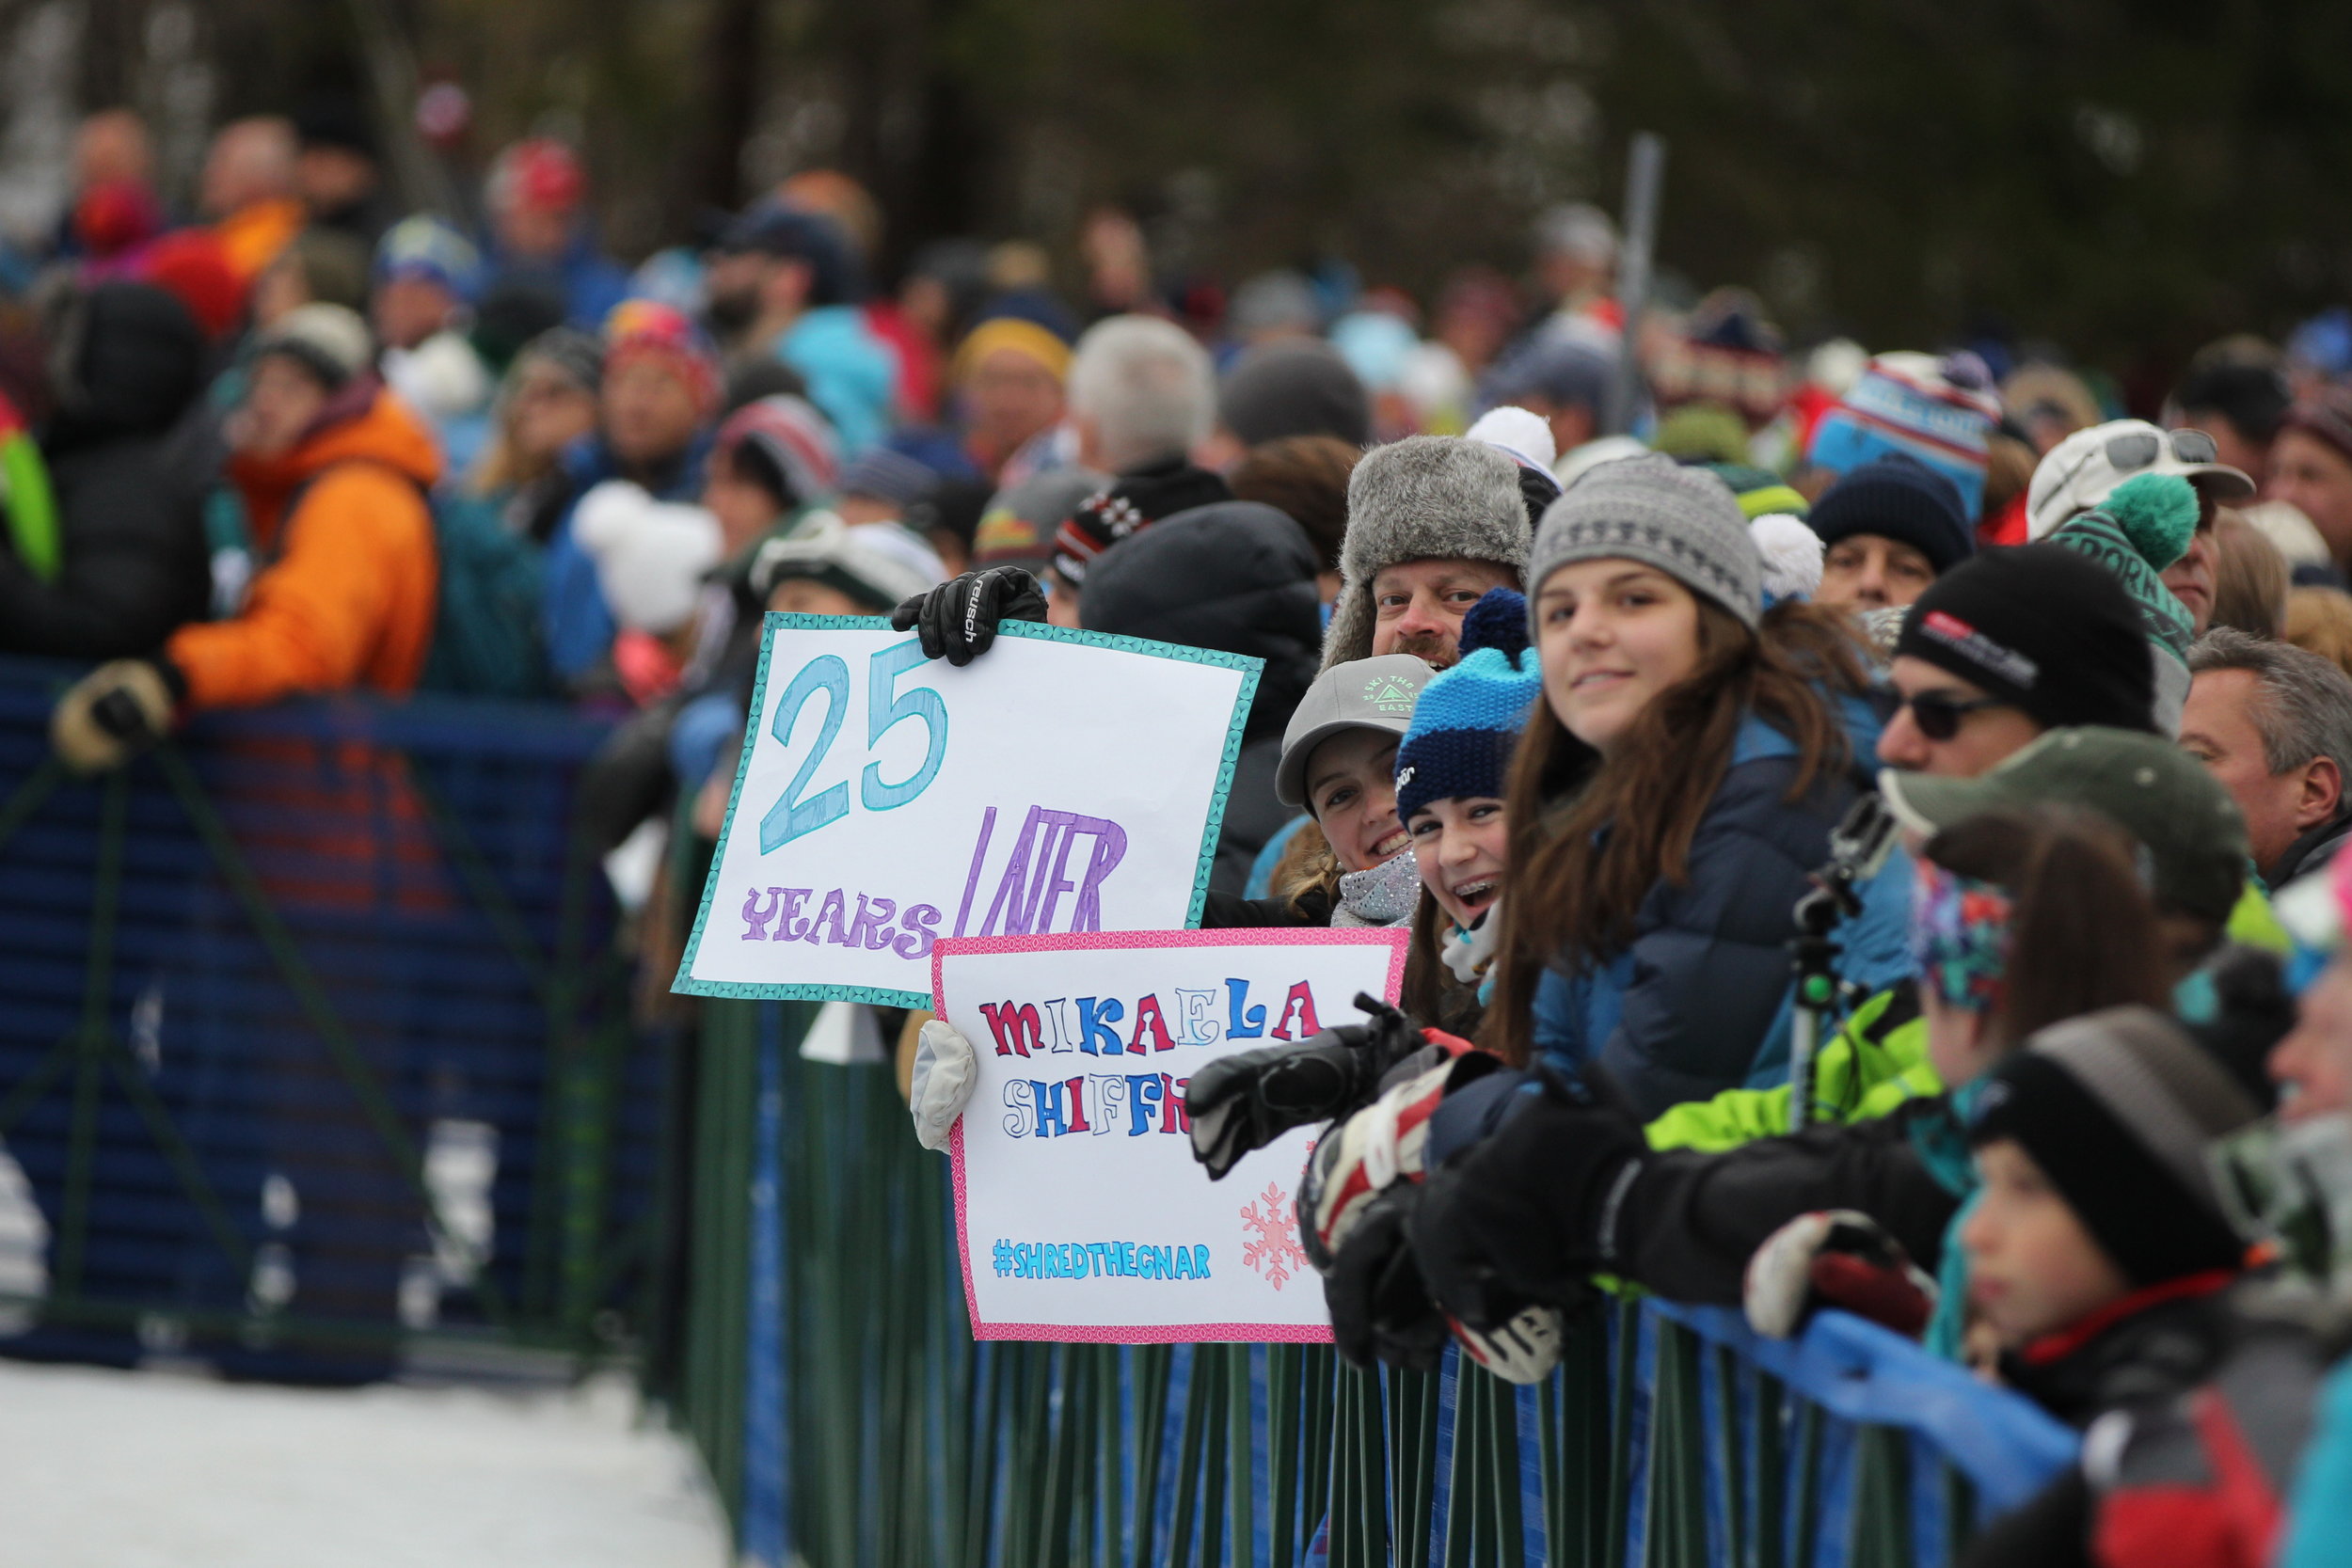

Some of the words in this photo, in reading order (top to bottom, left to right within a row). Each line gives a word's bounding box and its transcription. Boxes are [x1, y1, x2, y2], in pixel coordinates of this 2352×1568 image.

[964, 579, 984, 643] reusch
[1363, 676, 1384, 691] SKI
[1378, 704, 1413, 712] EAST
[759, 638, 949, 856] 25
[740, 886, 943, 960] YEARS
[952, 804, 1129, 939] LATER
[978, 977, 1326, 1058] MIKAELA
[1002, 1071, 1191, 1139] SHIFFR
[992, 1238, 1212, 1280] #SHREDTHEGNAR
